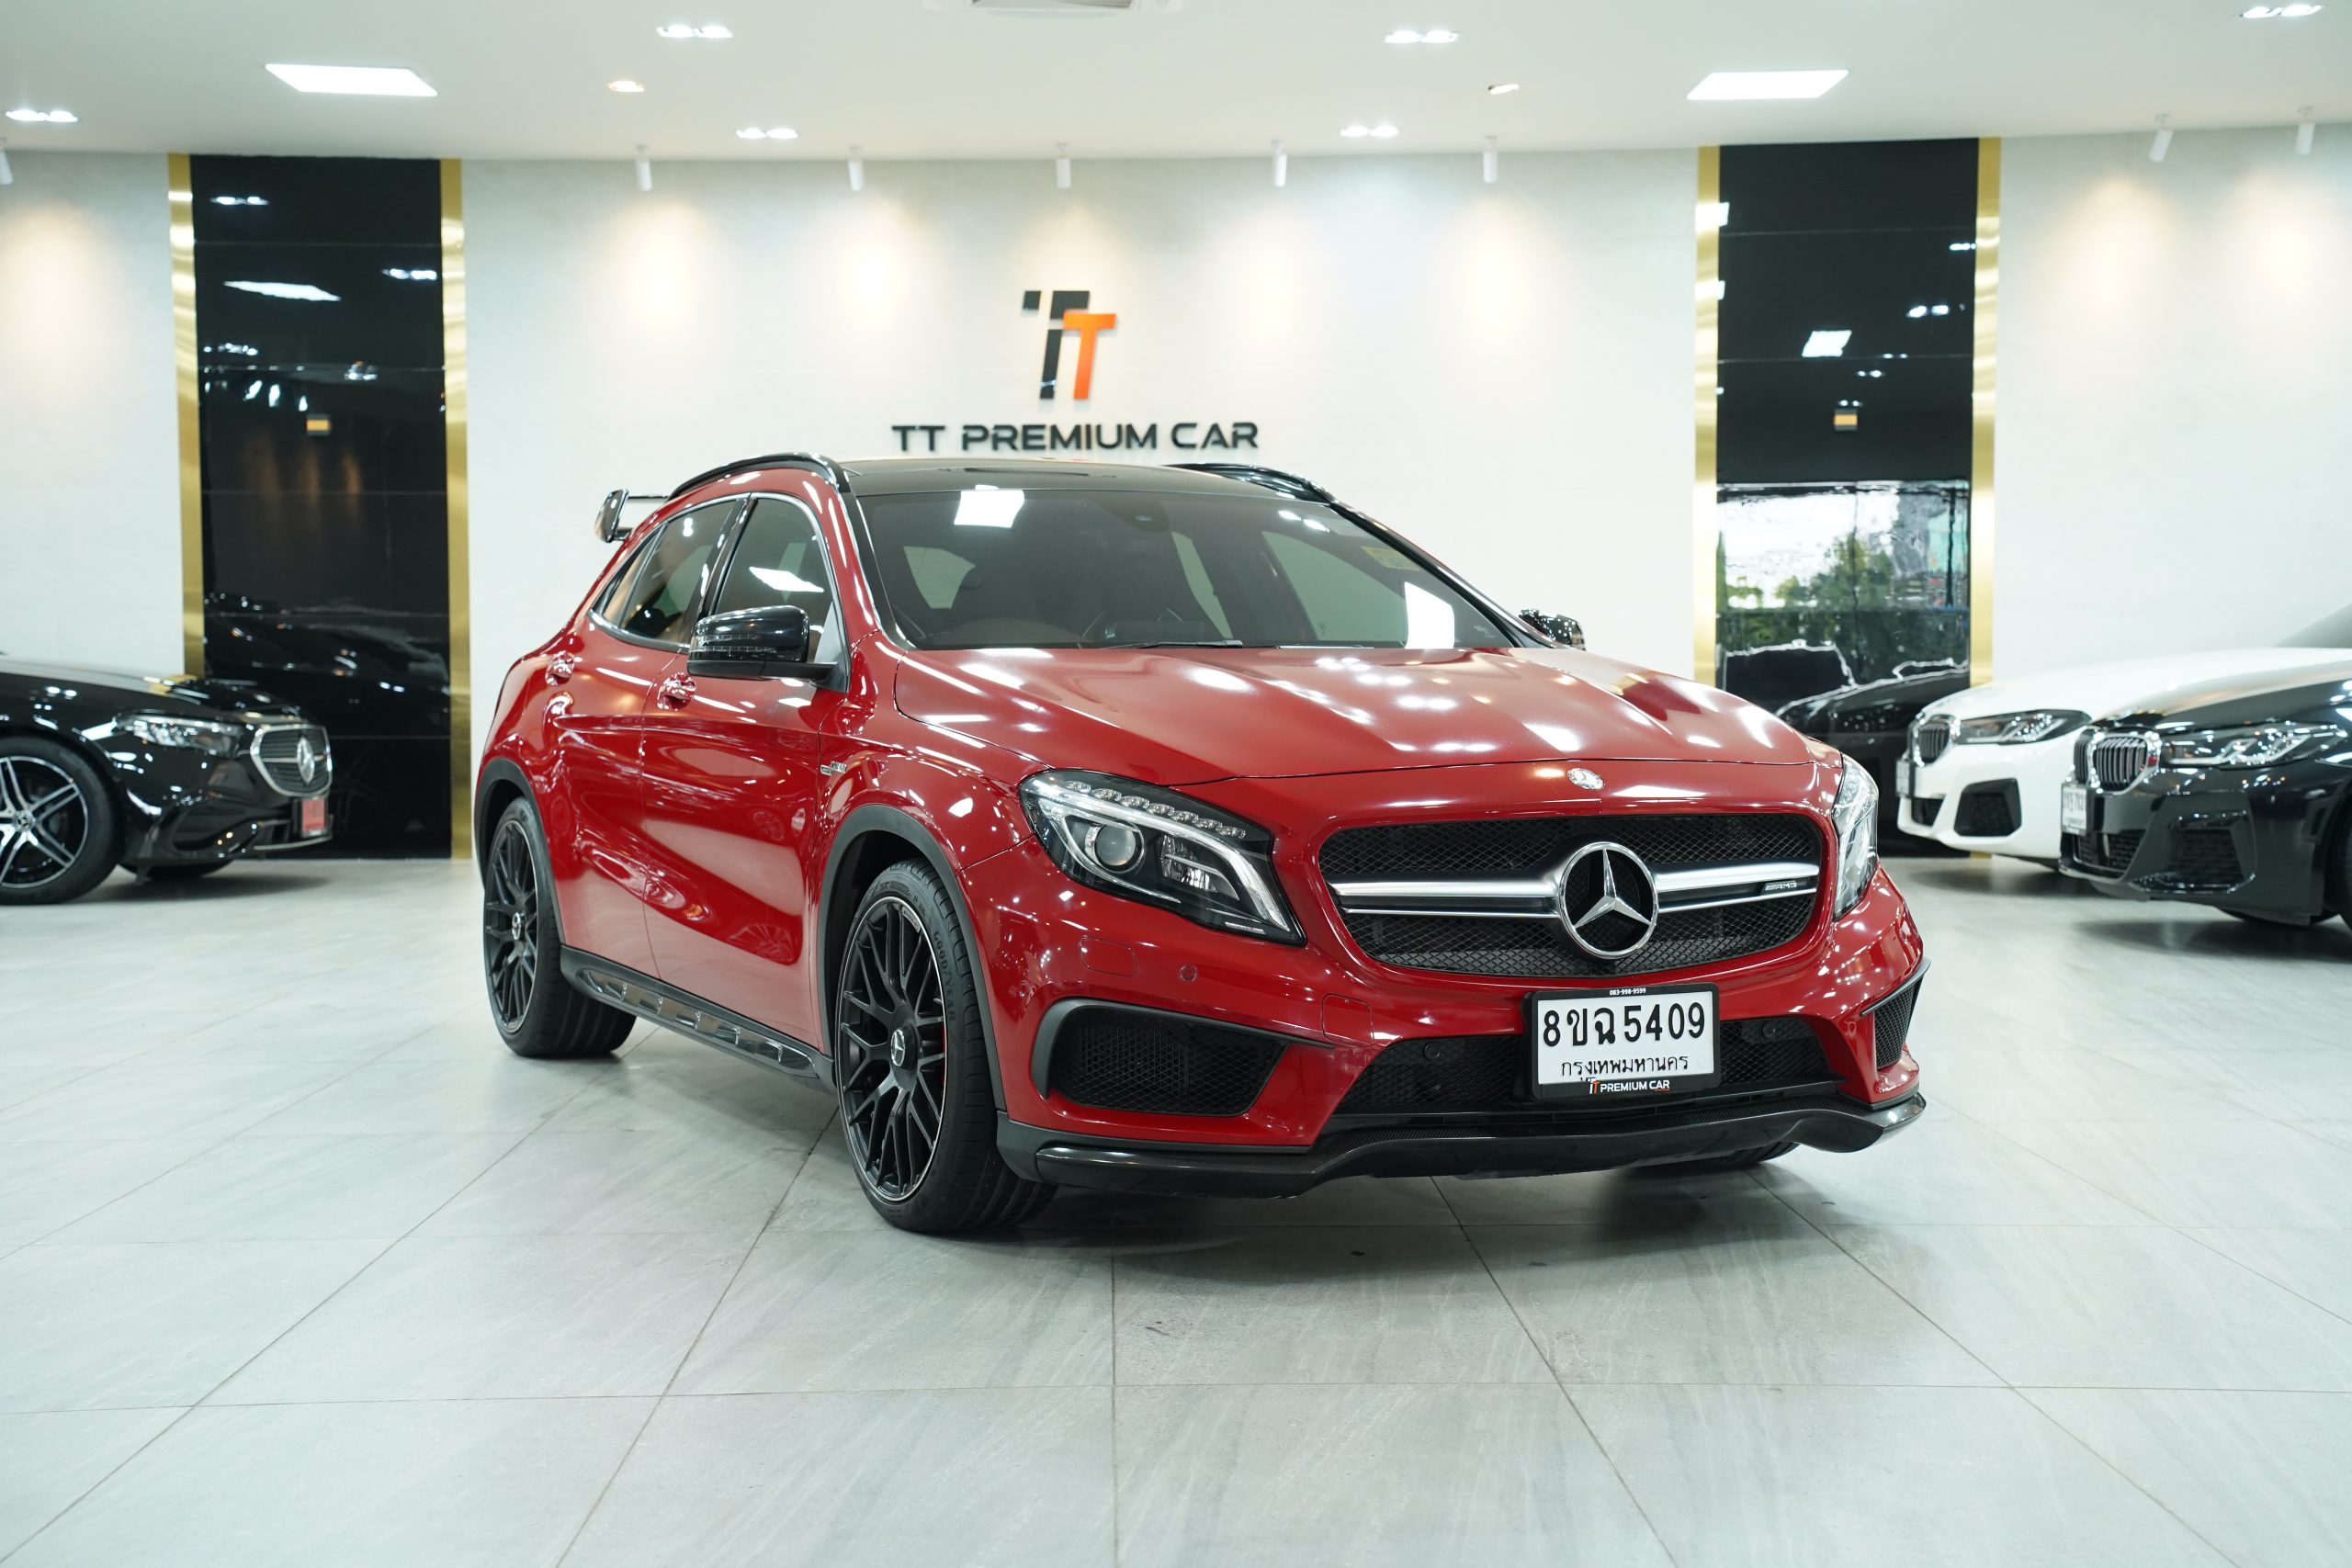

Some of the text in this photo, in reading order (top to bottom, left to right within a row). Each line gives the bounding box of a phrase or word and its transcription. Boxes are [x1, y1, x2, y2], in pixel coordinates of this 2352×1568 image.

[891, 422, 1259, 452] TT PREMIUM CAR
[1561, 1055, 1689, 1082] กรุงเทพมหานคร
[1600, 1080, 1647, 1093] PREMIUM
[1648, 1079, 1670, 1090] CAR
